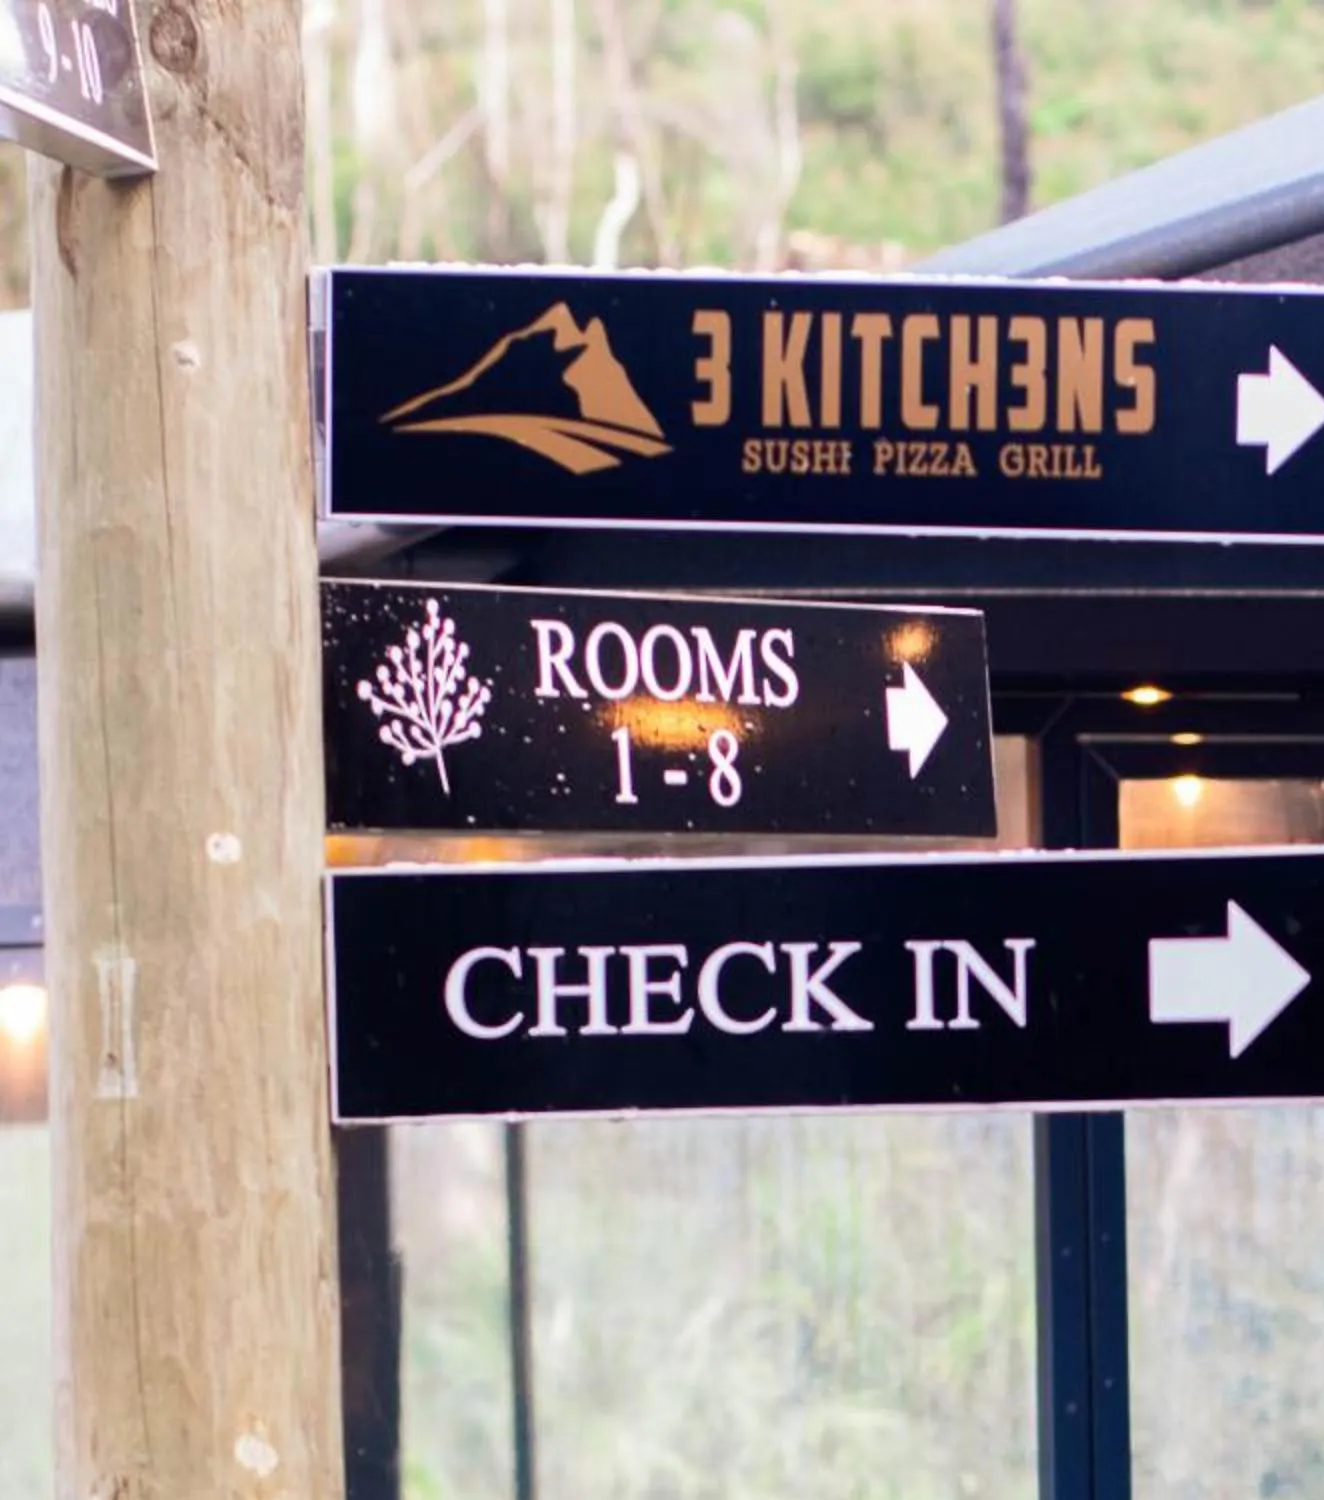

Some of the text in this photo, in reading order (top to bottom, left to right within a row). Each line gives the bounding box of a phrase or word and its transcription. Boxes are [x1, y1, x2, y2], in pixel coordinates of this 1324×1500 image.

[692, 310, 1156, 433] 3 KITCH3NS
[742, 438, 1103, 478] SUSHI PIZZA GRILL
[531, 619, 799, 708] ROOMS
[444, 938, 1036, 1040] CHECK IN
